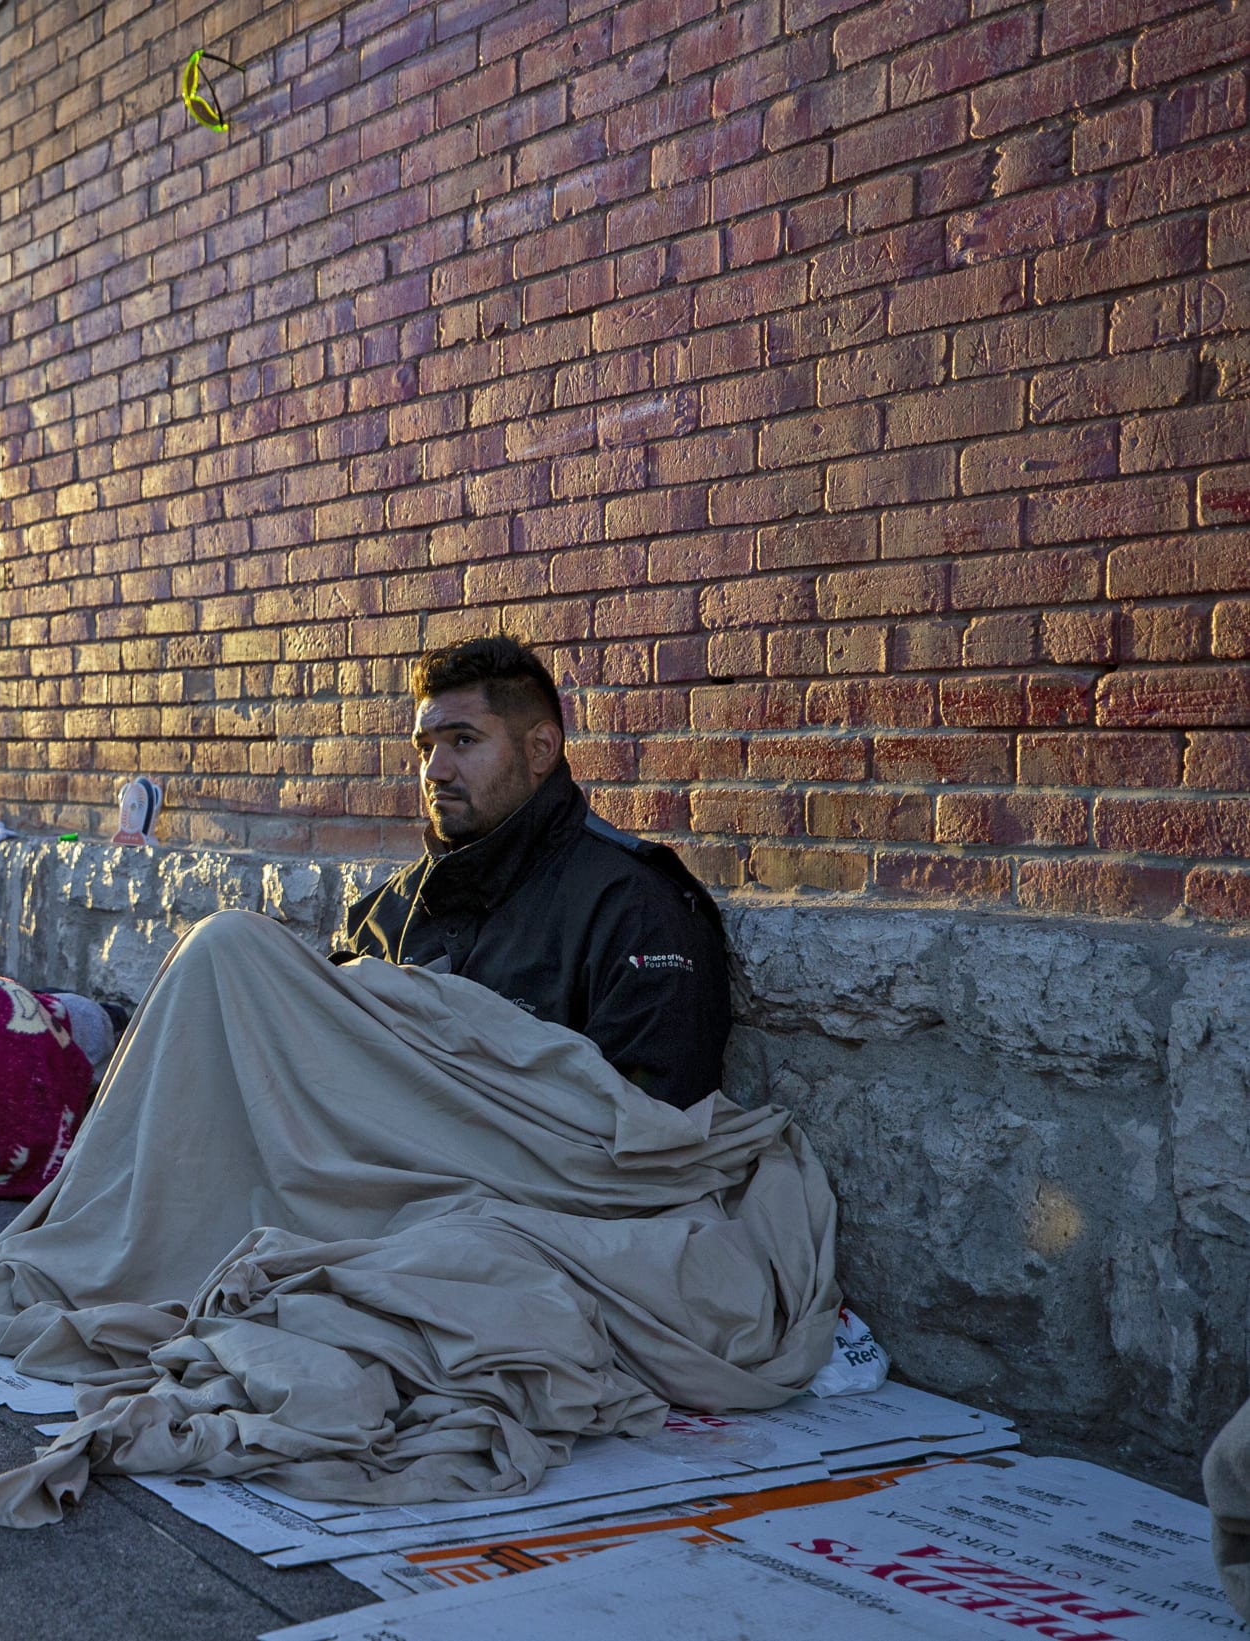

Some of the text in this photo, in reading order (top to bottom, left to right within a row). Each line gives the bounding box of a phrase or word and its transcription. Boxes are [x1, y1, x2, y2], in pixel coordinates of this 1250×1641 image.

[957, 1534, 1017, 1557] OUR
[786, 1538, 1129, 1641] PEEDY'S
[896, 1543, 1150, 1624] PIZZA
[1113, 1584, 1181, 1611] WILL
